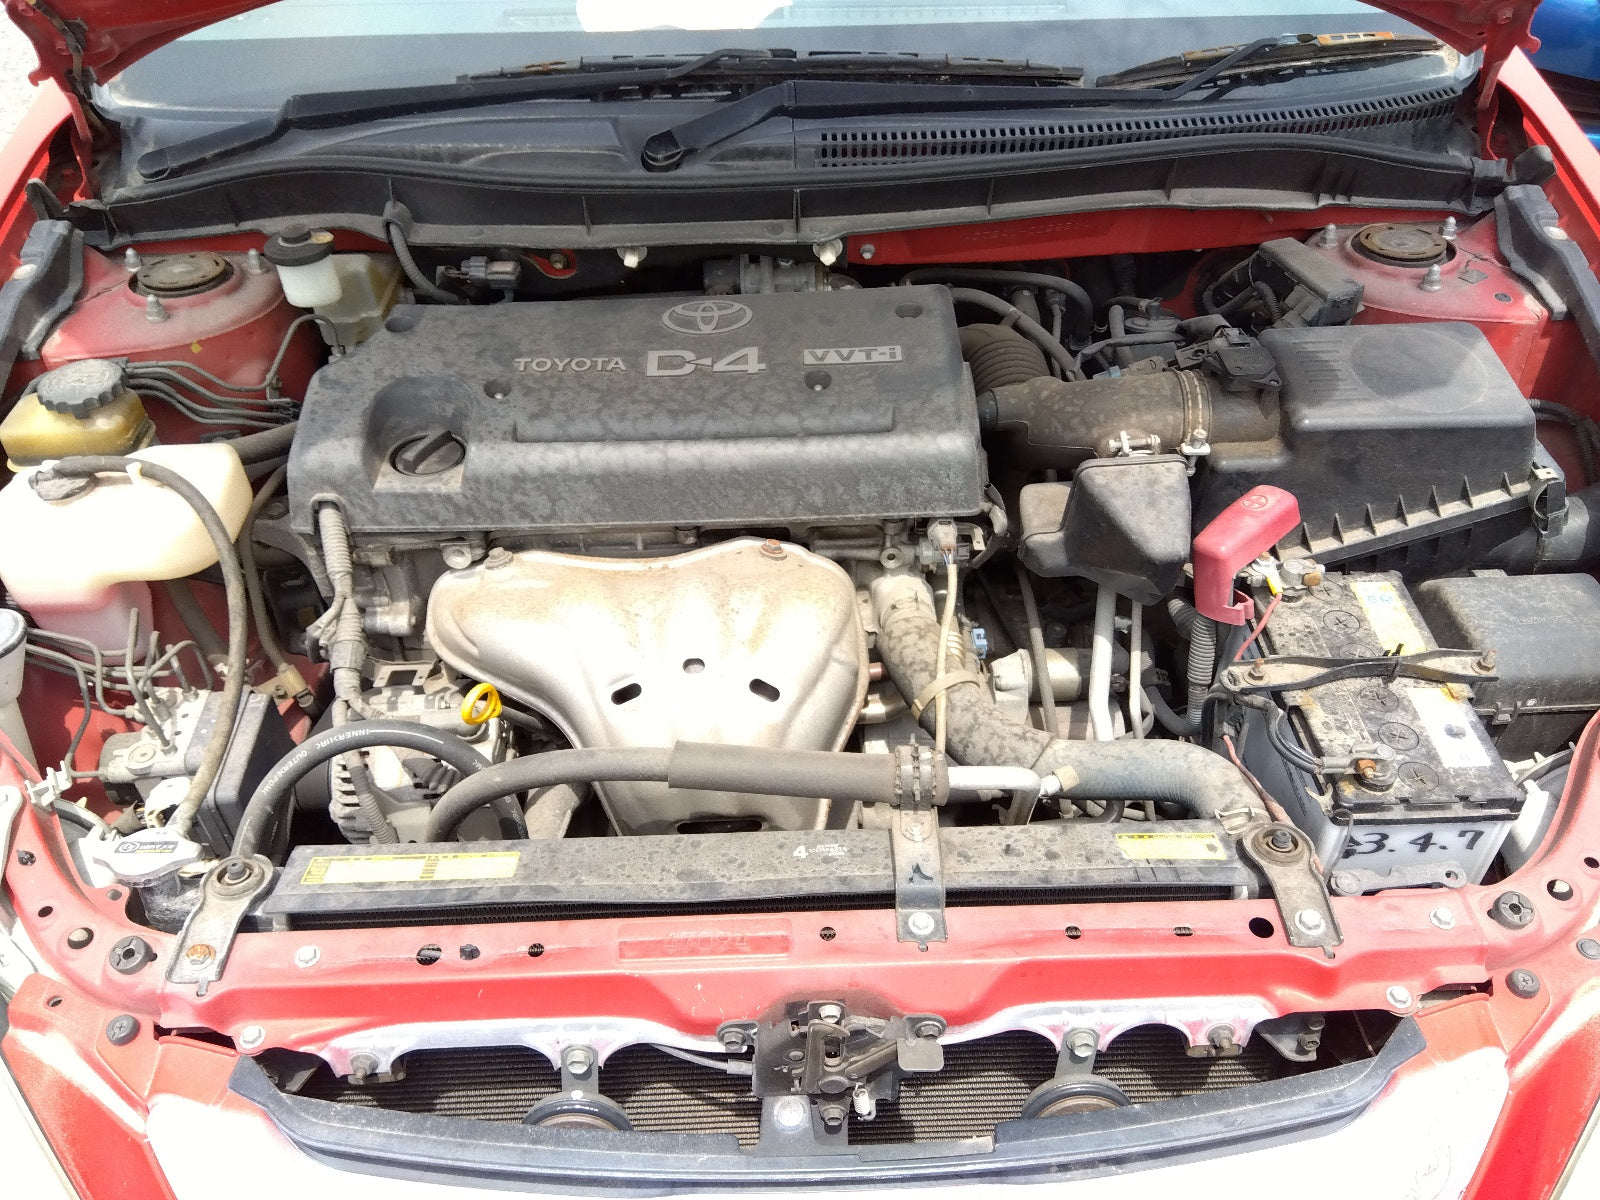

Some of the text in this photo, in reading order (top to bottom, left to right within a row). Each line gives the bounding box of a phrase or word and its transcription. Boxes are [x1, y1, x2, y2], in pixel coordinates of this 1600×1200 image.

[513, 346, 900, 377] TOYOTA D-4 VVT-i
